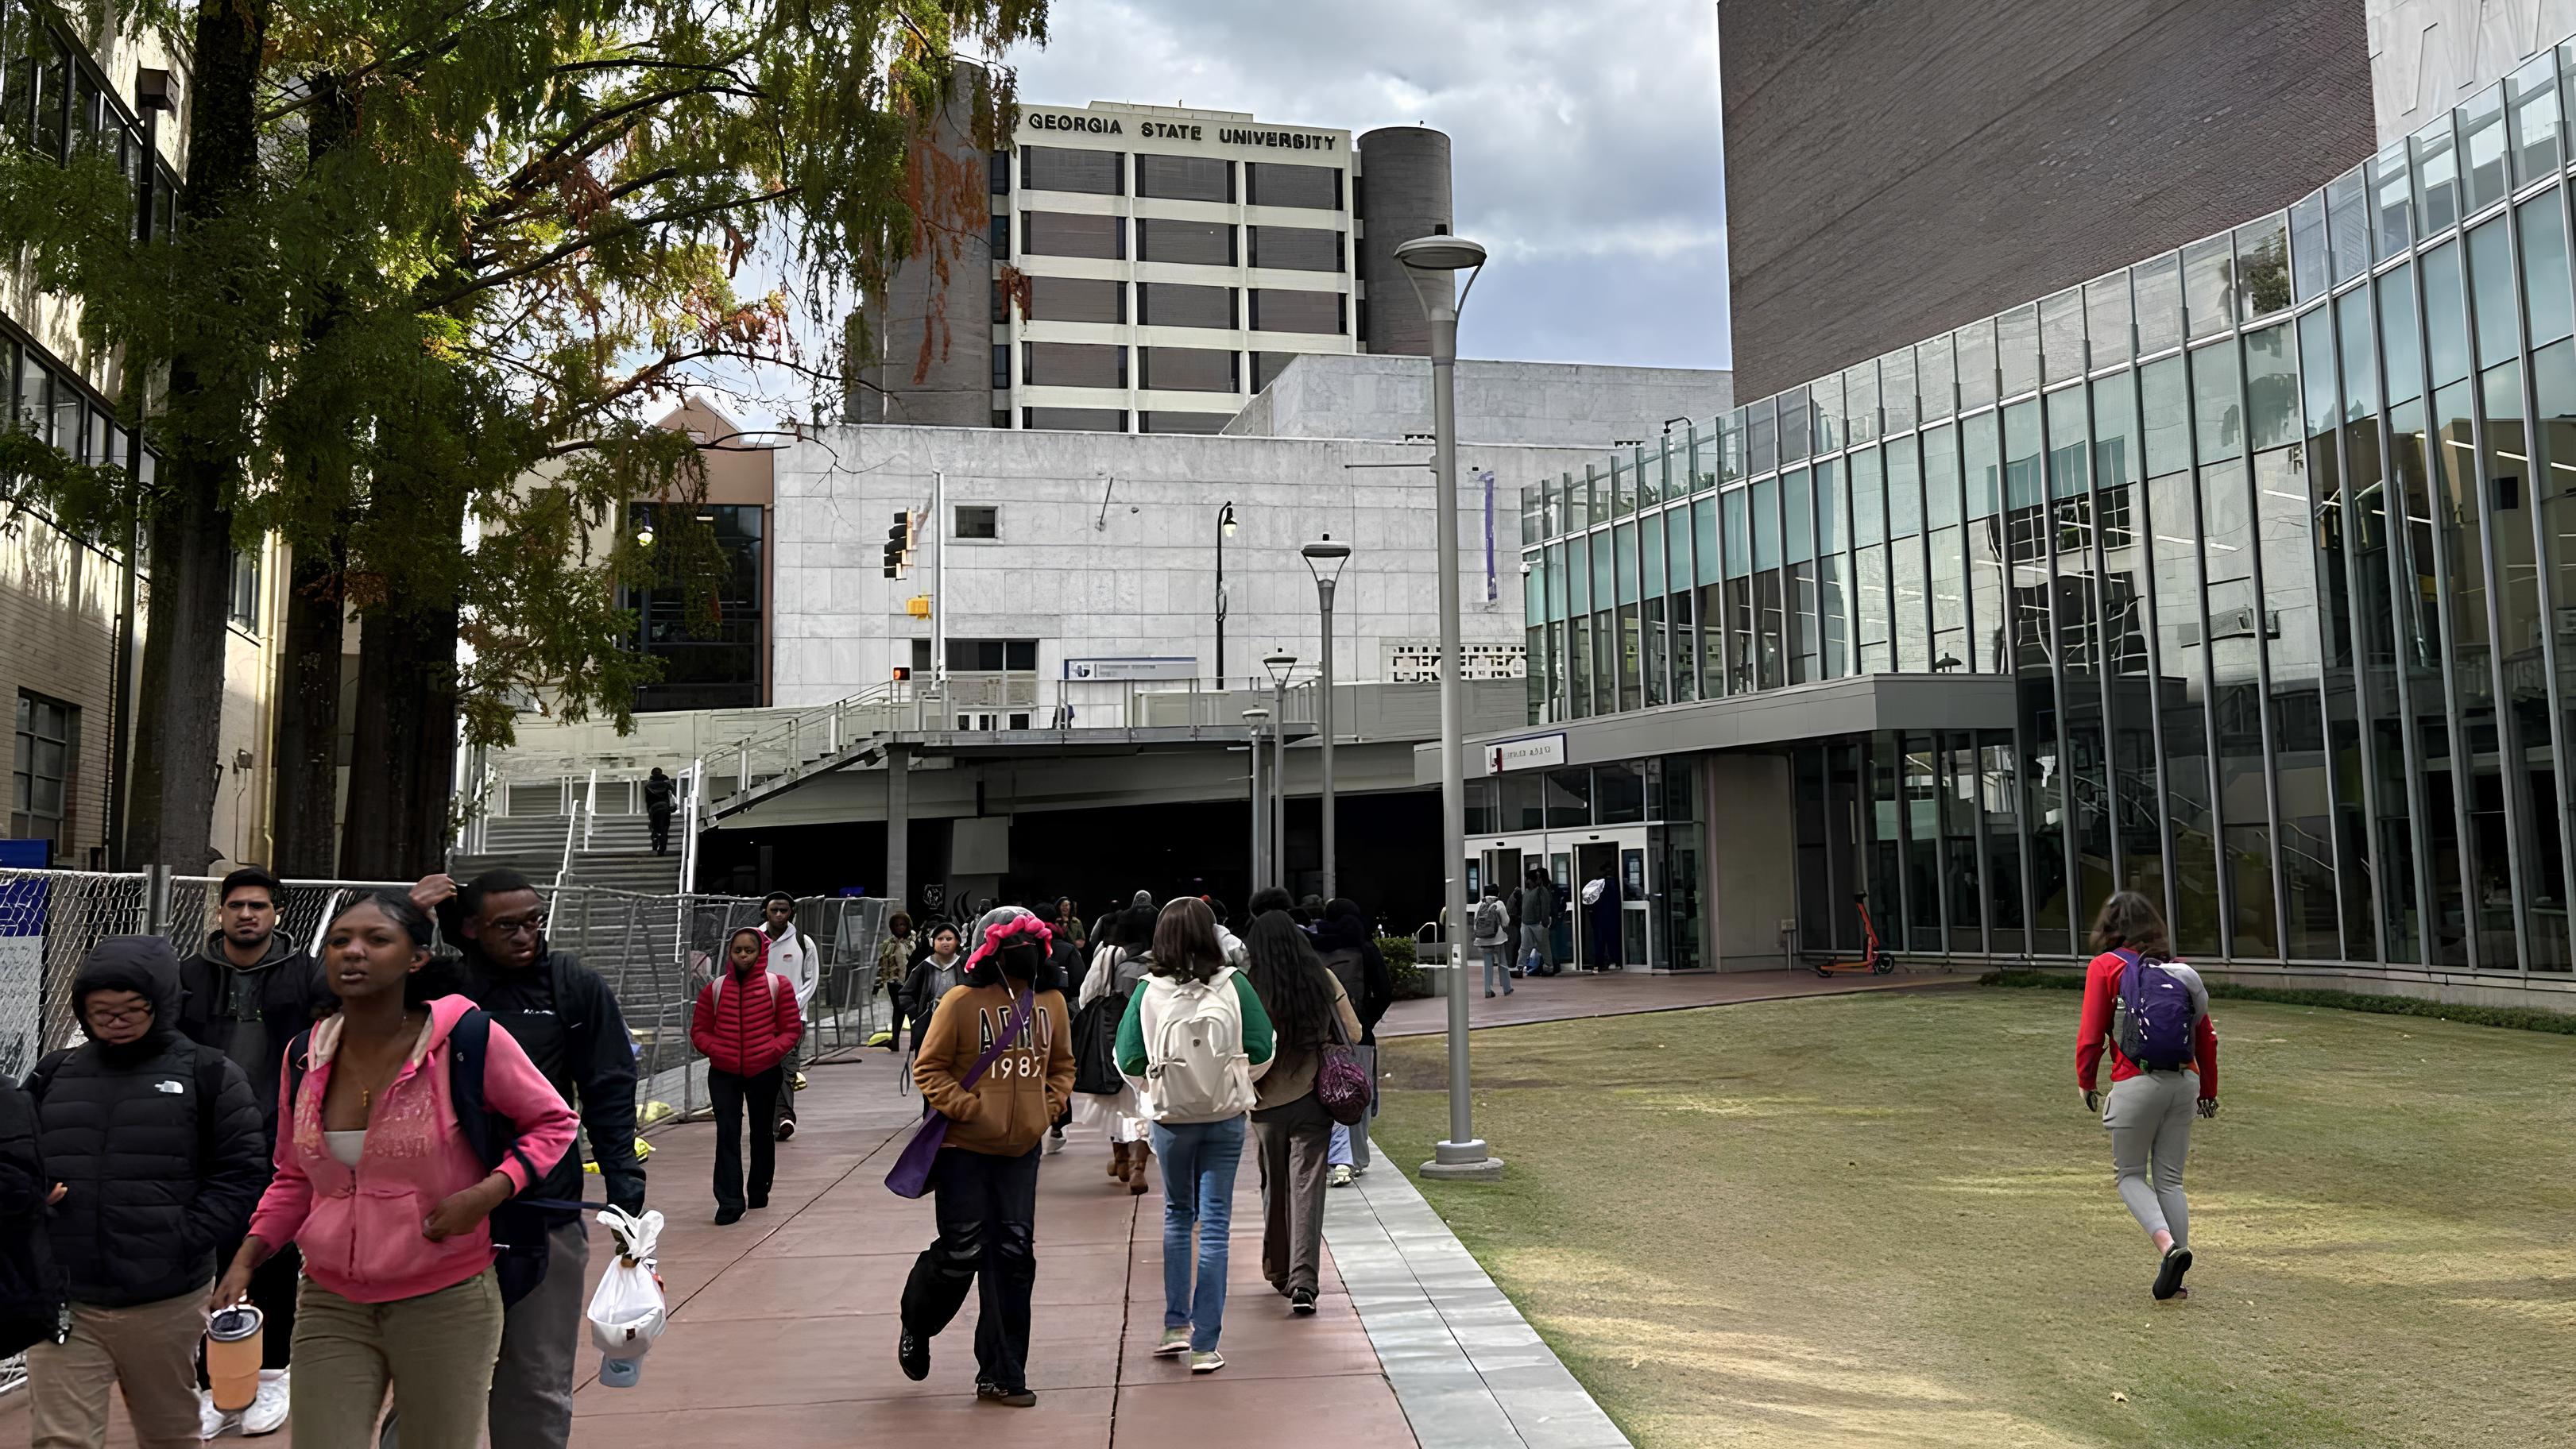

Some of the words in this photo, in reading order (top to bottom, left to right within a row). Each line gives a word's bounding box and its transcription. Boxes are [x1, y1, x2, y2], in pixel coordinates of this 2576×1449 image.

[1028, 113, 1123, 134] GEORGIA
[1141, 122, 1202, 141] STATE
[1219, 128, 1336, 150] UNIVERSITY
